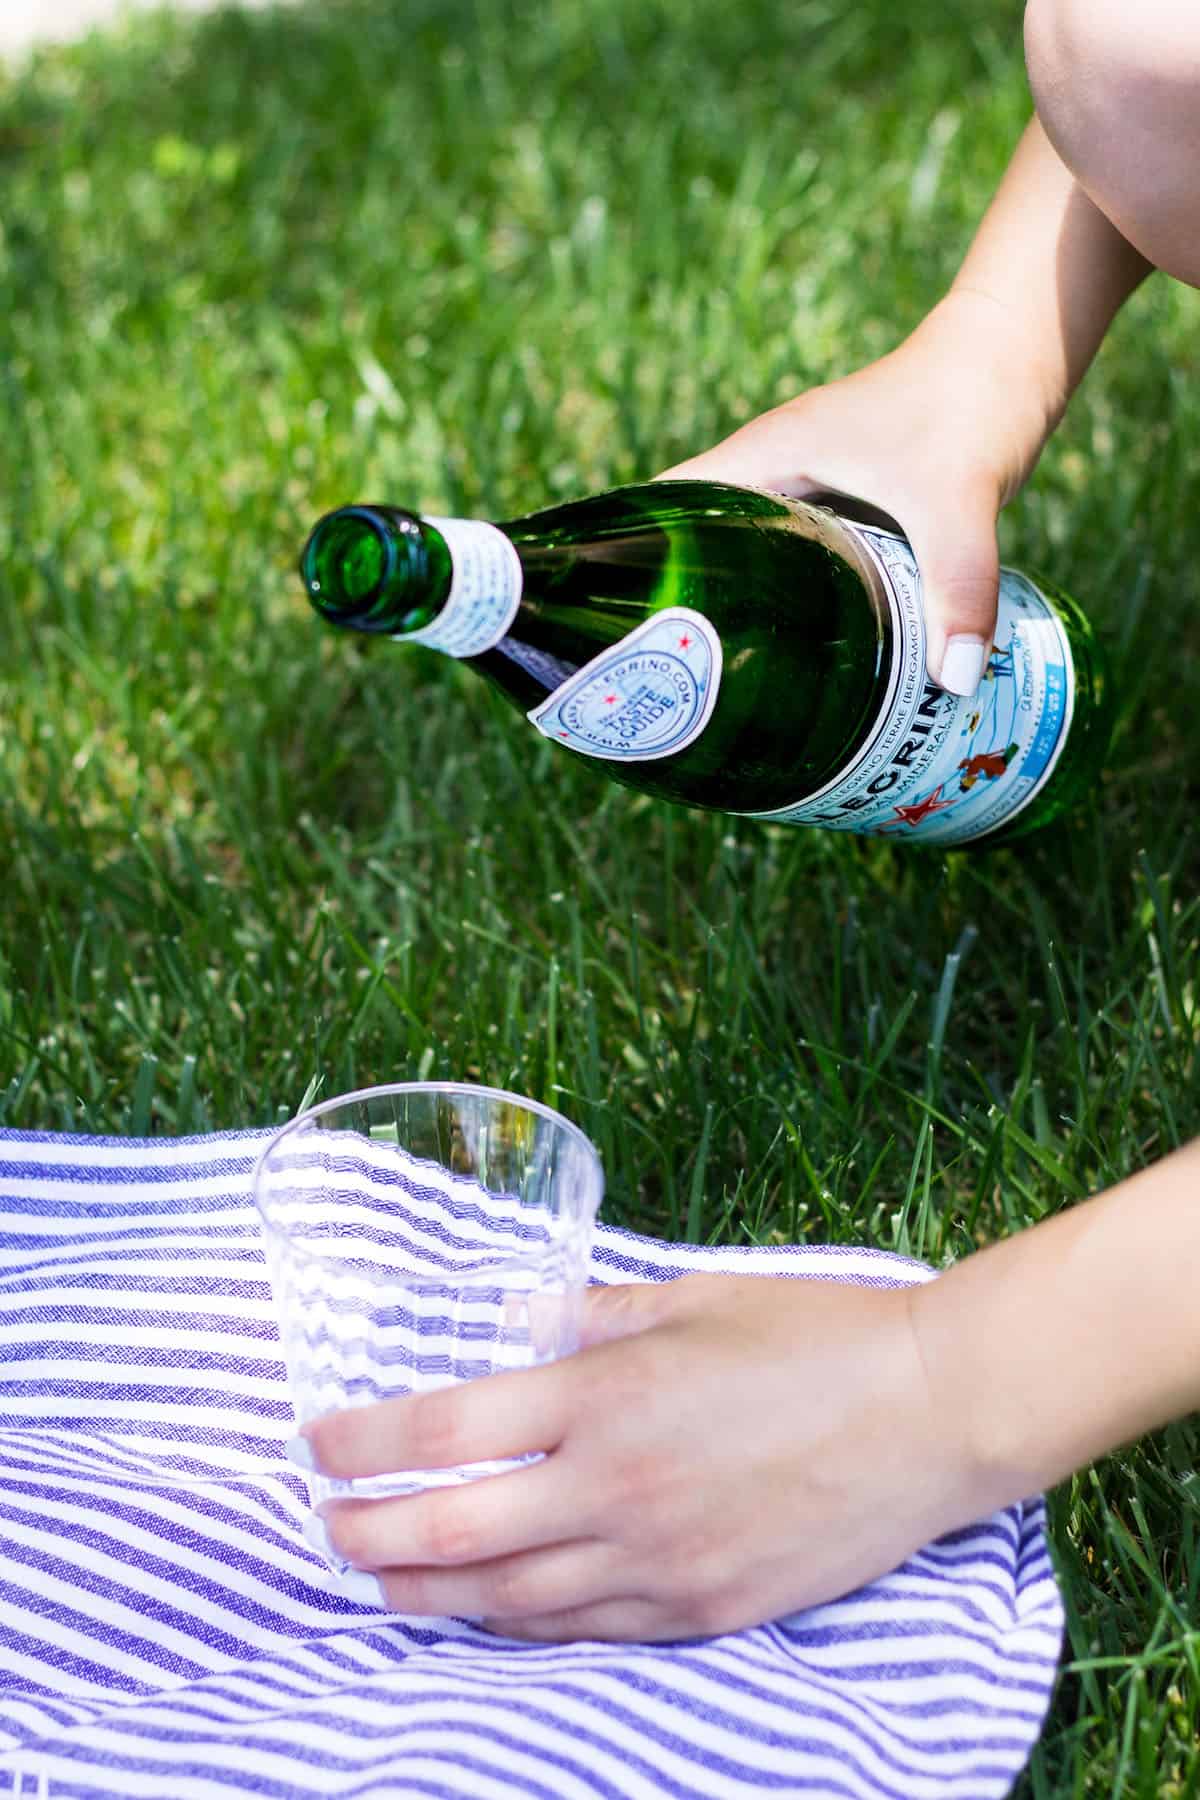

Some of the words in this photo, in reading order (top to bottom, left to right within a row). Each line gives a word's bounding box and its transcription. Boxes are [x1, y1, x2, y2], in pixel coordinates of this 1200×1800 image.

[882, 710, 907, 750] TERME
[903, 619, 921, 704] (BERGAMO)
[606, 688, 661, 731] TASTE
[620, 696, 676, 739] GUIDE
